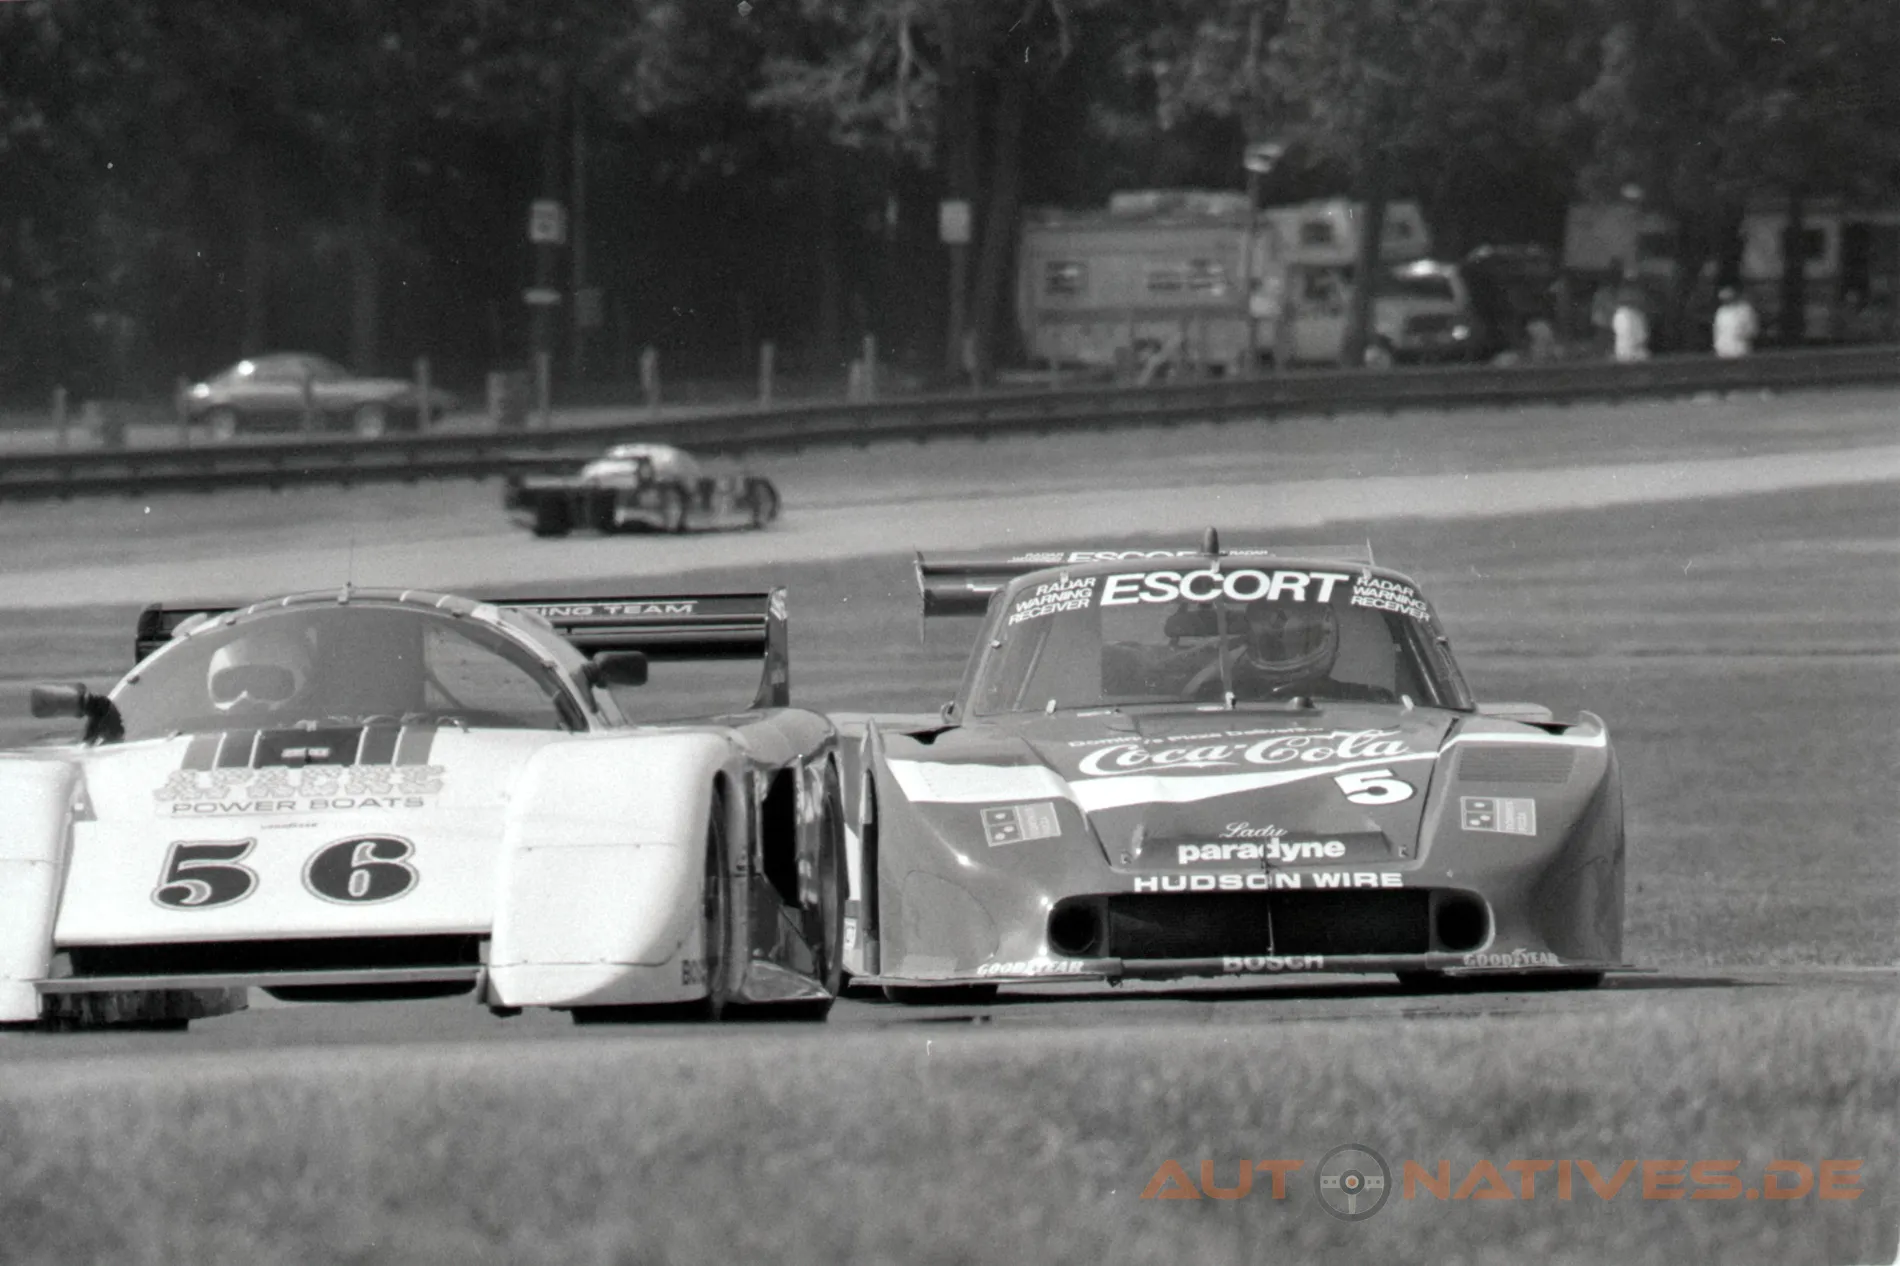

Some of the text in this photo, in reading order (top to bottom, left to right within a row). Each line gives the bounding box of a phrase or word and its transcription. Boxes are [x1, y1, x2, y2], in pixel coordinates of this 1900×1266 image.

[1036, 577, 1096, 596] RADAR
[1100, 569, 1350, 606] ESCORT
[1351, 585, 1427, 611] WARNING
[1356, 576, 1415, 596] RADAR
[603, 603, 694, 616] TEAM
[1008, 598, 1090, 626] RECEIVER
[1015, 588, 1092, 612] WARNING
[1350, 595, 1431, 622] RECEIVER
[1079, 729, 1408, 776] Coca-Cola
[1333, 768, 1417, 805] 5
[172, 796, 426, 815] POWER BOATS
[1177, 838, 1346, 864] paradyne
[1133, 871, 1404, 894] HUDSON WIRE
[1222, 955, 1325, 972] BOSCH
